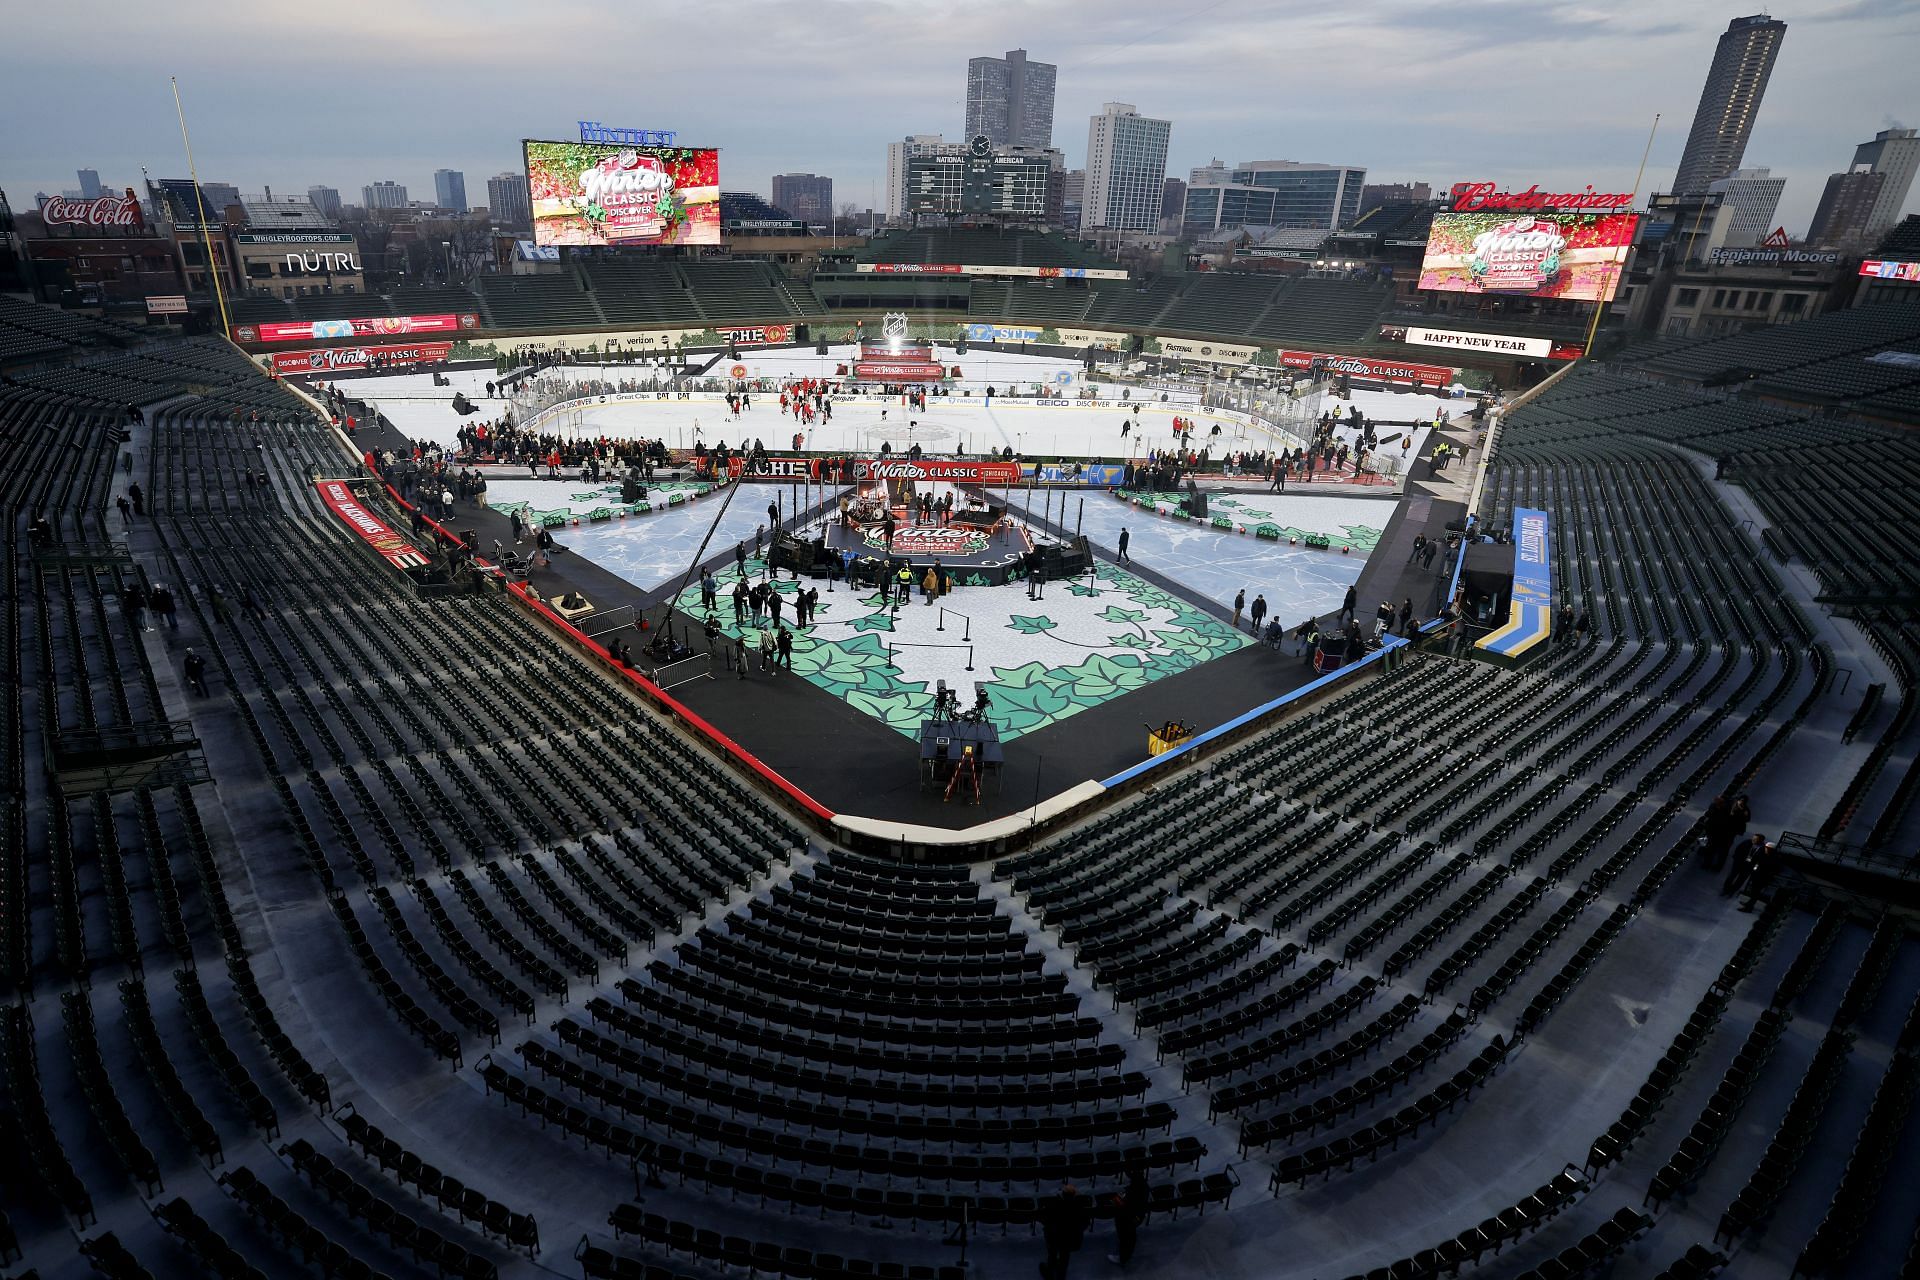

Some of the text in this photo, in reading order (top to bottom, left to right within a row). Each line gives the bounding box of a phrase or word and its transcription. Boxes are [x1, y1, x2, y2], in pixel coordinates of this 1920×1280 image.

[578, 120, 677, 147] WINTRUST
[579, 167, 675, 201] Winter
[604, 193, 657, 205] CLASSIC
[1450, 181, 1634, 210] Budweiser
[43, 195, 136, 225] Coca-Cola
[610, 205, 652, 217] DISCOVER
[252, 234, 341, 242] WRIGLEYROOFTOPS.COM
[1472, 228, 1567, 258] Winter
[1489, 252, 1545, 261] CLASSIC
[1710, 248, 1836, 262] Benjamin Moore
[1493, 262, 1536, 272] DISCOVER
[889, 320, 903, 334] NHL
[626, 336, 654, 345] verizon
[729, 329, 759, 342] CHI
[999, 329, 1031, 340] STL
[1064, 334, 1090, 342] DISCOVER
[1424, 333, 1526, 351] HAPPY NEW YEAR
[278, 358, 309, 367] DISCOVER
[324, 348, 375, 370] Winter
[377, 349, 420, 361] CLASSIC
[1218, 350, 1248, 358] DISCOVER
[1283, 356, 1446, 380] DISCOVER Winter CLASSIC CHICAGO
[656, 392, 670, 400] CAT
[677, 392, 690, 400] CAT
[1036, 399, 1069, 407] GEICO
[1076, 400, 1110, 408] DISCOVER
[755, 461, 797, 476] CHI
[869, 460, 928, 481] Winter
[929, 468, 977, 478] CLASSIC
[337, 502, 385, 534] BLACKHAWKS
[1520, 536, 1539, 553] LOUIS
[1520, 553, 1539, 563] ST.
